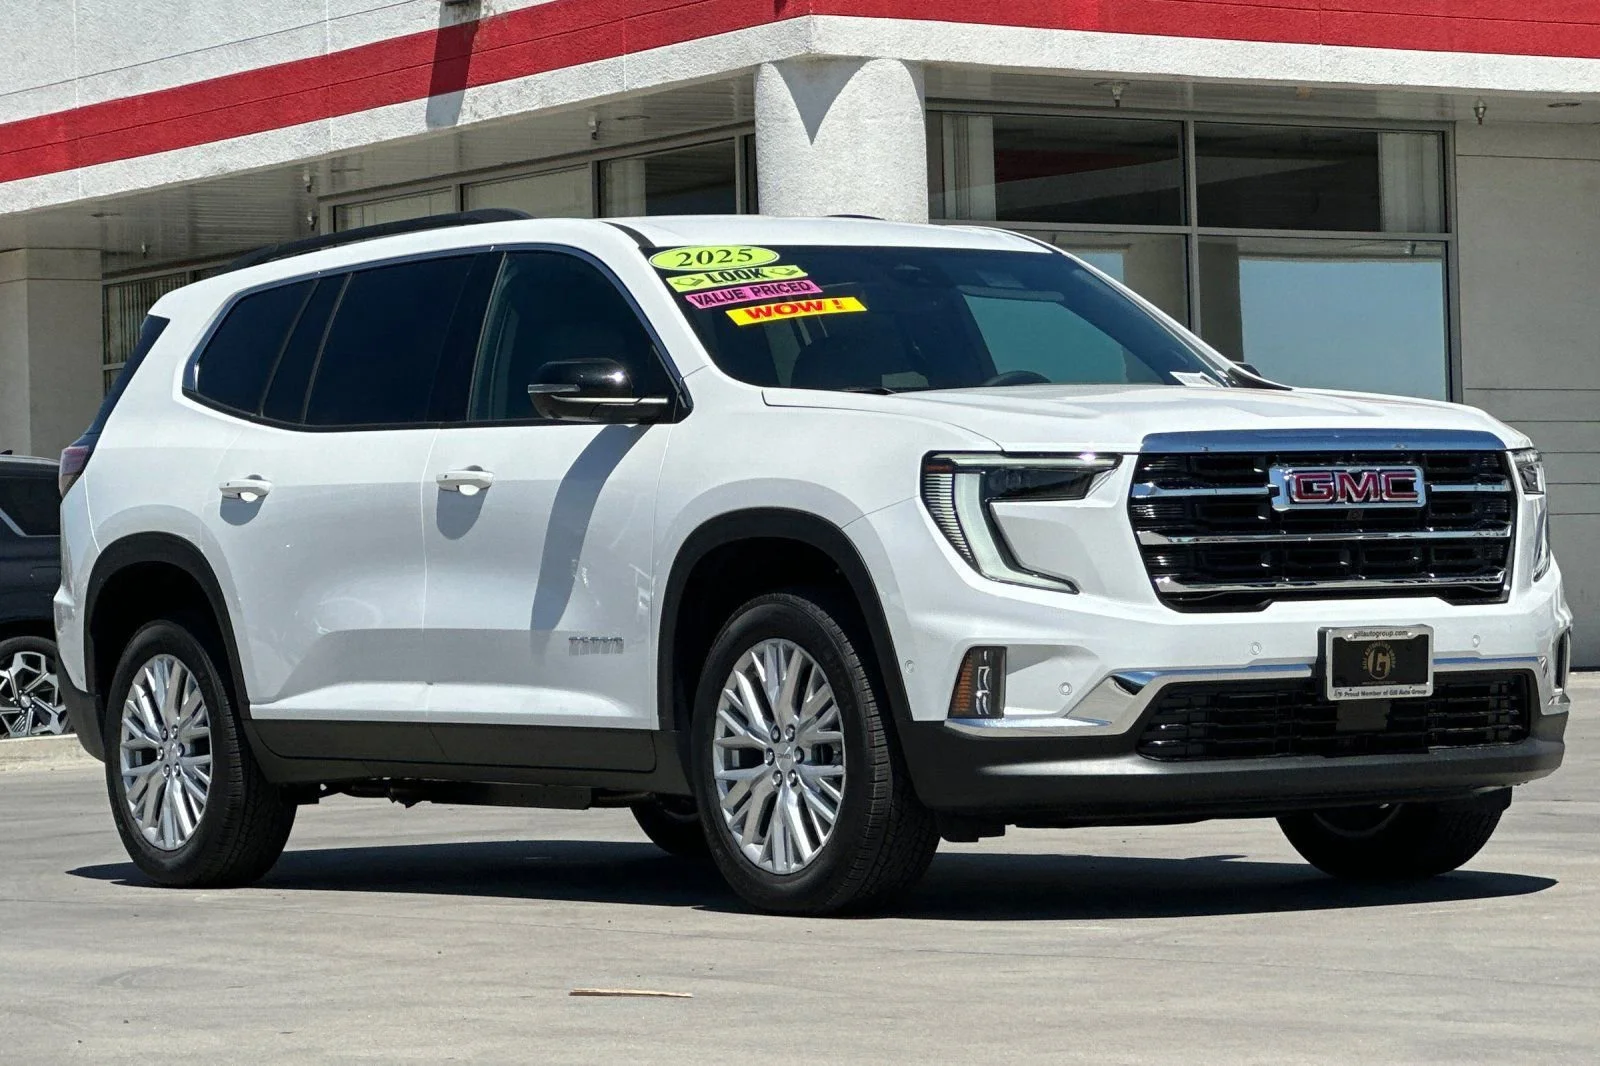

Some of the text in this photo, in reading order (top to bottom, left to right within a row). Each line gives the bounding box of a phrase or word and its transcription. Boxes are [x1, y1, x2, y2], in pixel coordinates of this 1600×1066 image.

[675, 248, 753, 267] 2025
[704, 268, 769, 284] LOOK
[691, 281, 812, 307] VALUE PRICED
[744, 300, 824, 320] WOW
[1290, 471, 1419, 502] GMC
[1353, 631, 1408, 639] gillautogroup.com
